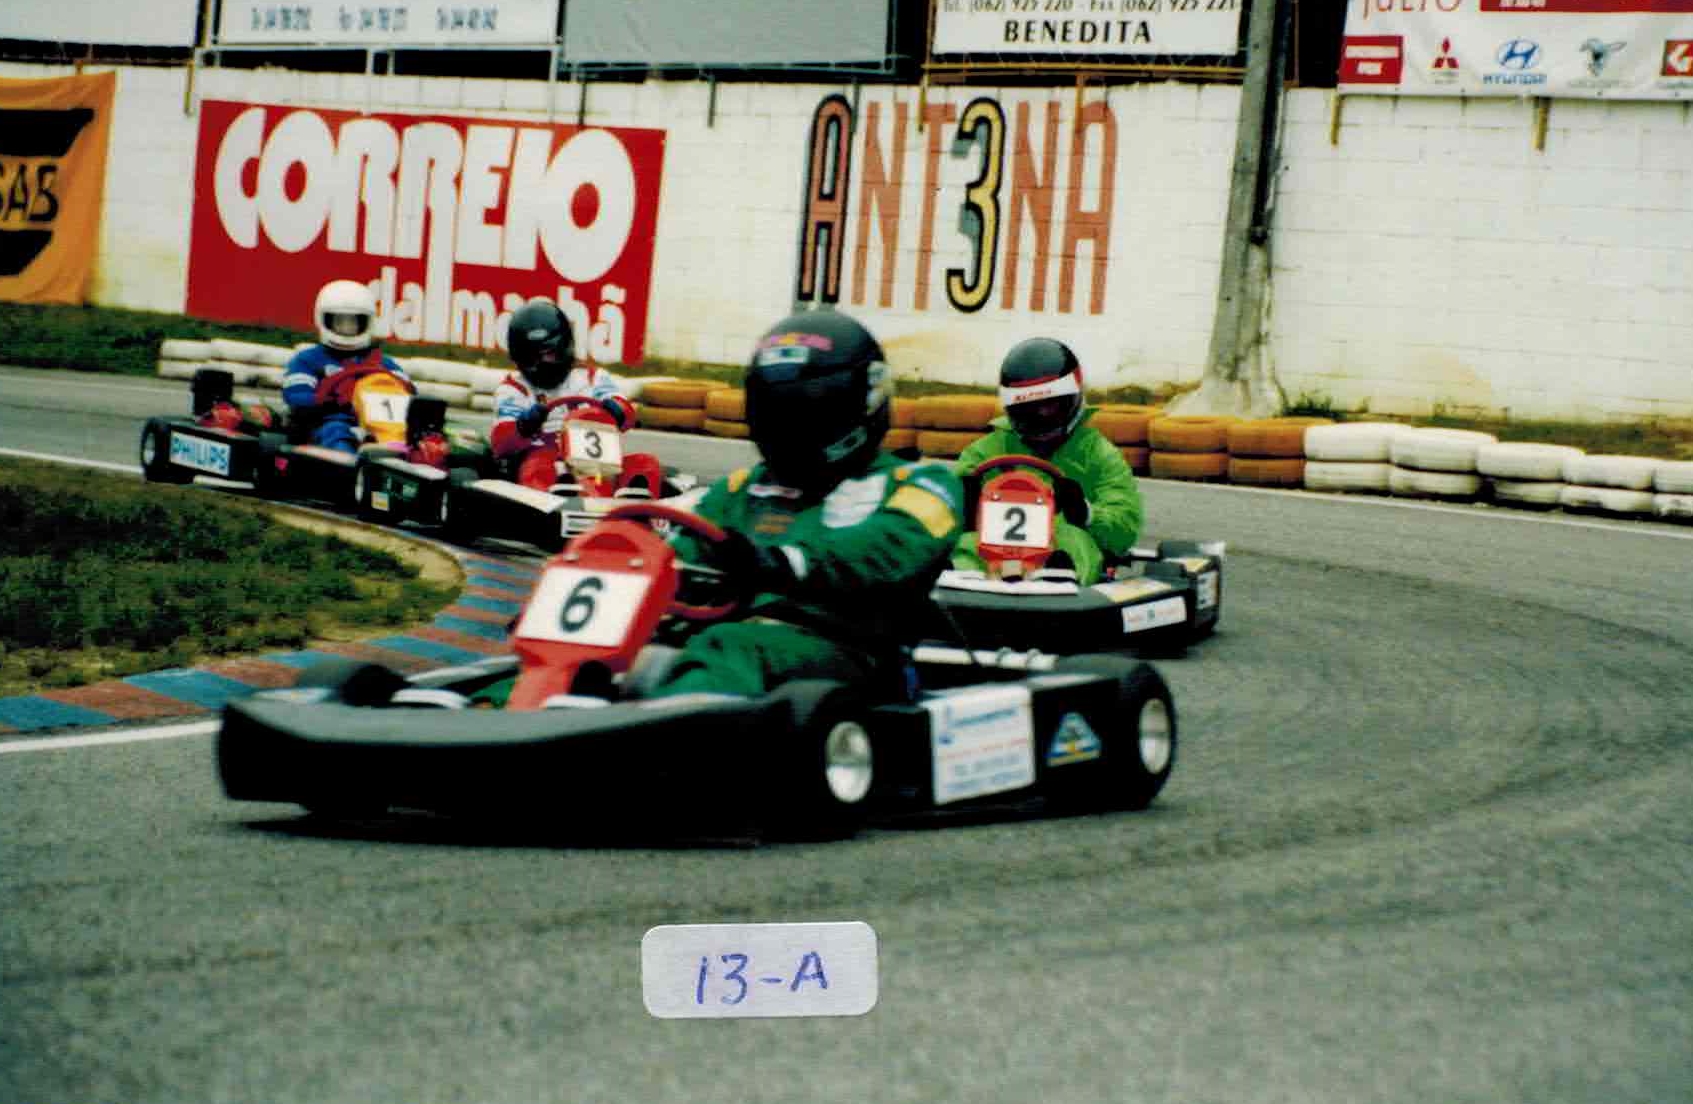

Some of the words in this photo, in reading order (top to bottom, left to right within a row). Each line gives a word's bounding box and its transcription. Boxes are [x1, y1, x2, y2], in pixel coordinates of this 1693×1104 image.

[1004, 19, 1151, 44] BENEDITA
[214, 106, 636, 341] CORREIO
[797, 94, 1118, 314] ANT3NA
[451, 283, 627, 364] mahã
[381, 399, 395, 421] 1
[583, 431, 603, 459] 3
[1003, 506, 1028, 542] 2
[560, 576, 604, 633] 6
